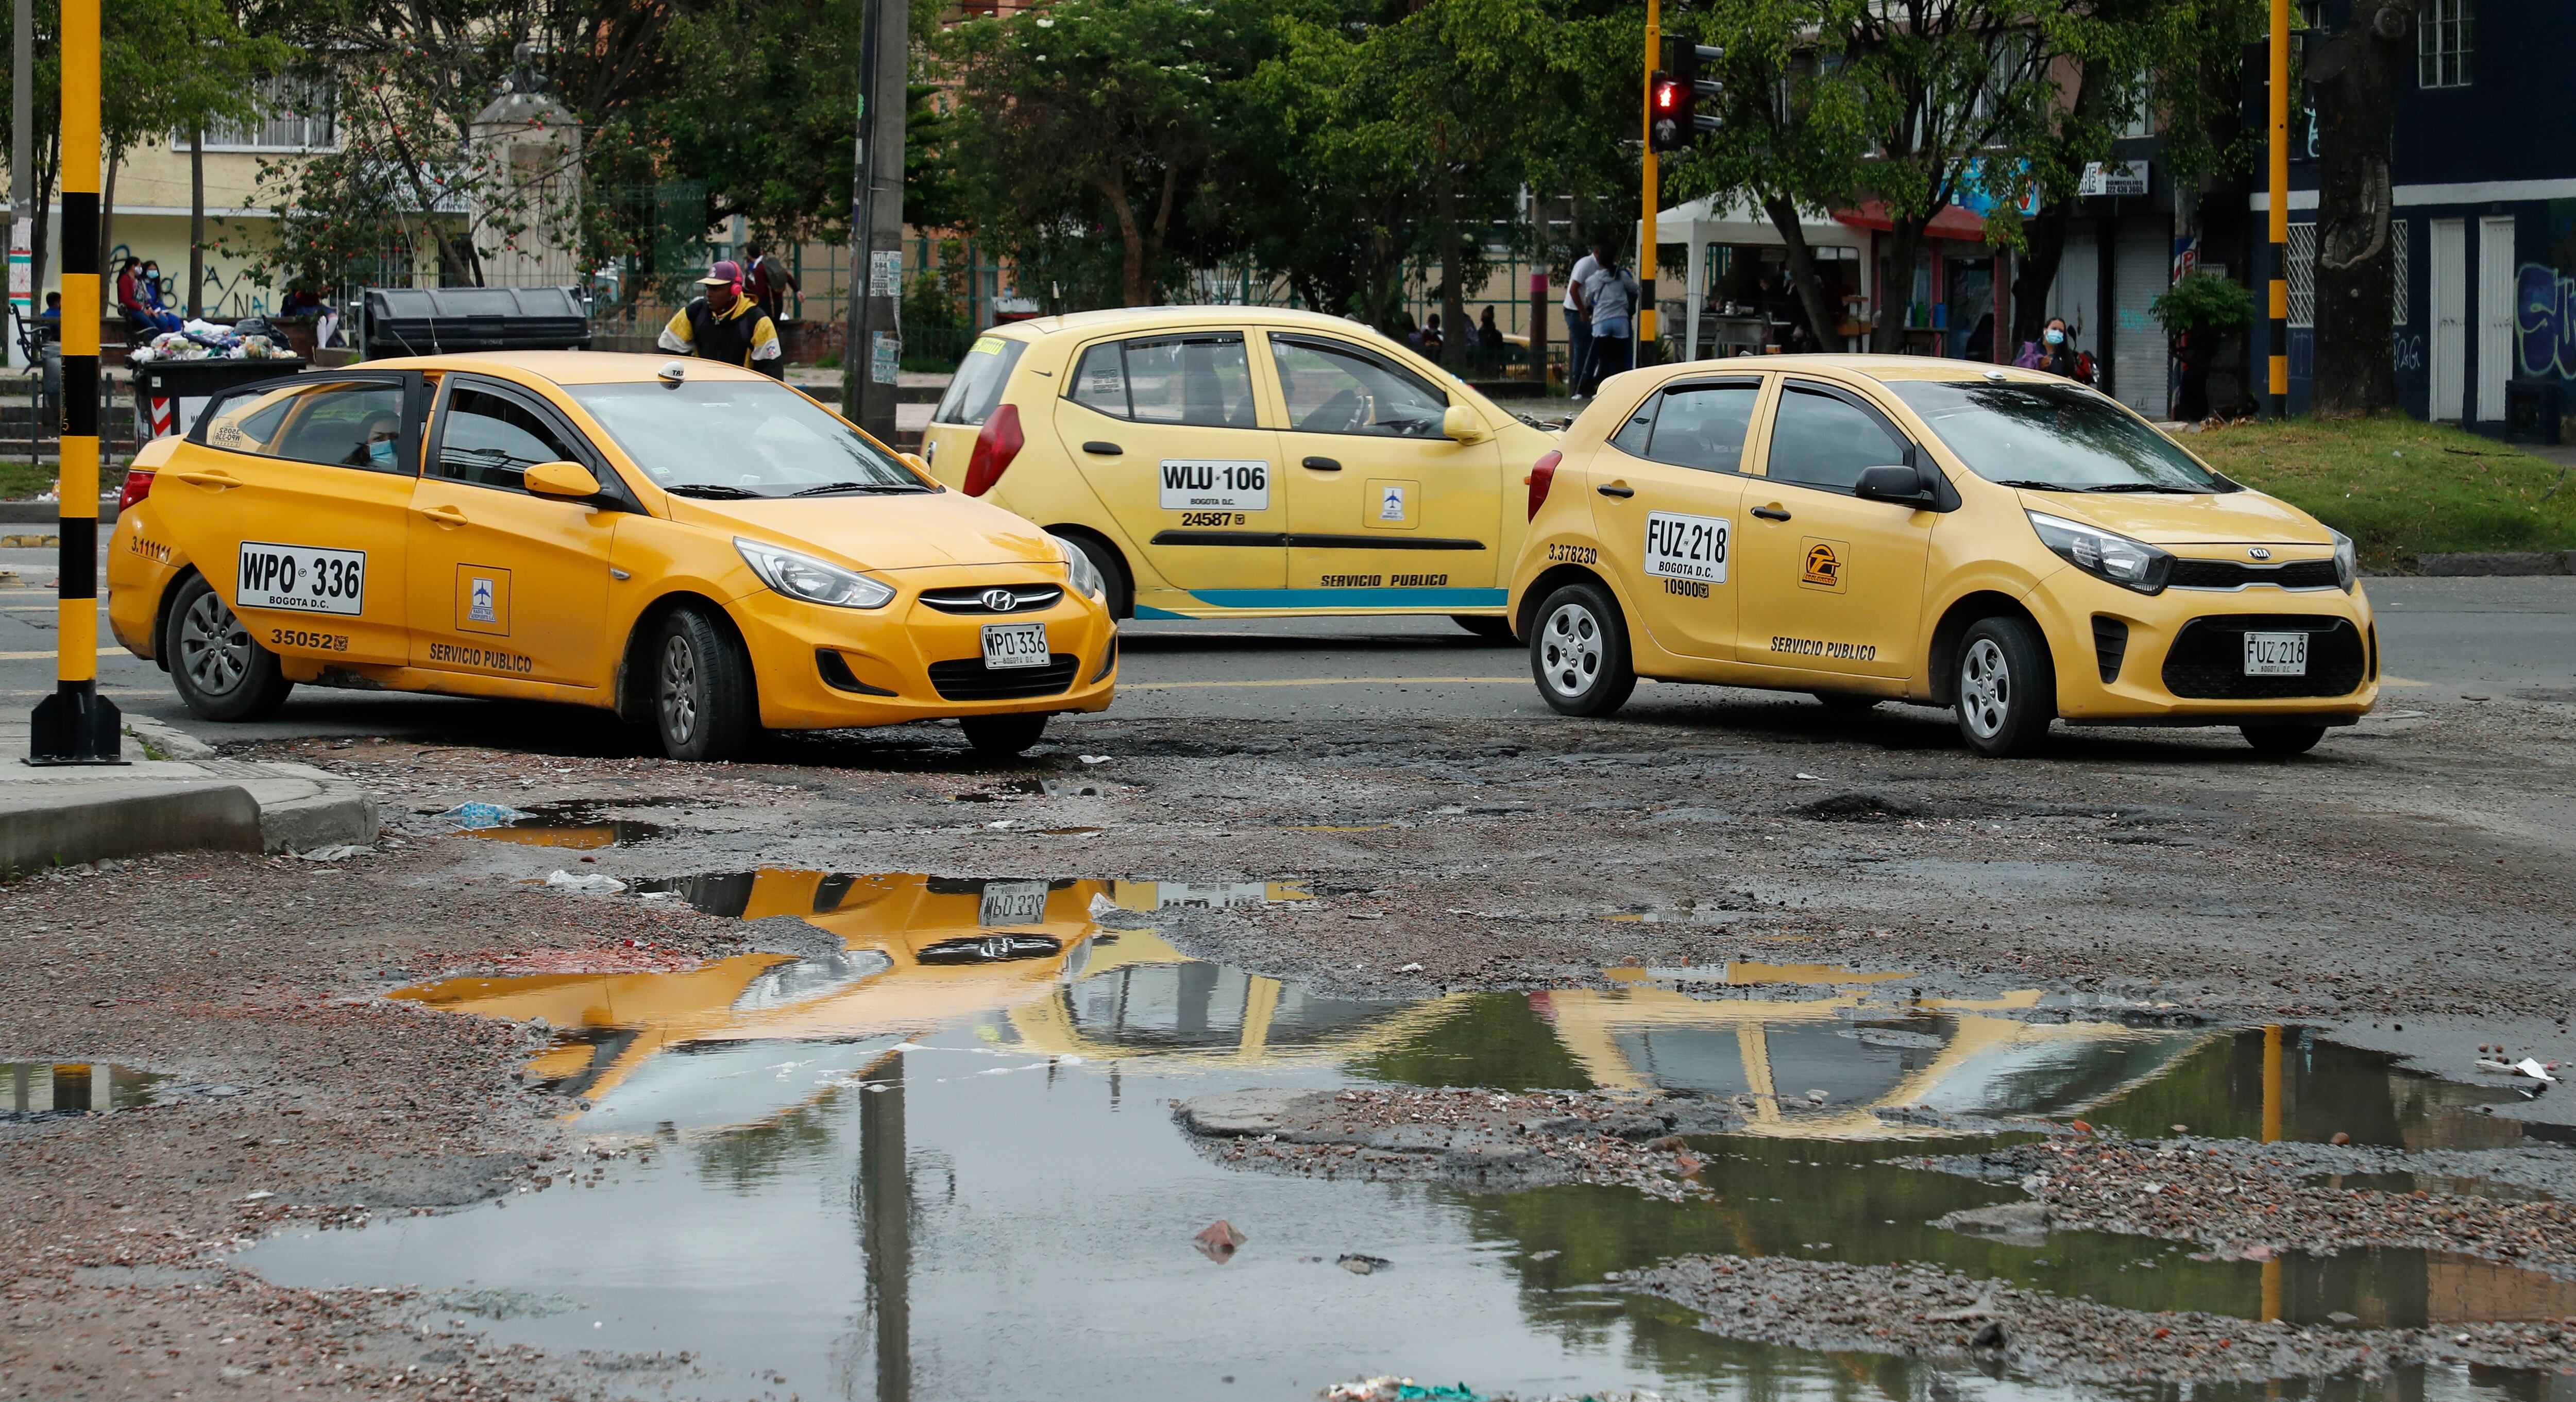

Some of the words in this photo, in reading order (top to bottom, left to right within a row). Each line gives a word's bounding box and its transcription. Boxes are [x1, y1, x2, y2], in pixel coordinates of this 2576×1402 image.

[1163, 466, 1212, 490] WLU
[1223, 467, 1265, 490] 106
[1182, 512, 1231, 526] 24587
[1648, 519, 1685, 558] FUZ
[1690, 524, 1727, 563] 218
[1548, 543, 1597, 565] 3.378230
[2251, 549, 2270, 557] KIA
[243, 552, 297, 594] WPO
[312, 557, 360, 599] 336
[1321, 574, 1382, 587] SERVICIO
[1390, 574, 1448, 586] PUBLICO
[1658, 561, 1693, 575] BOGOTA
[1695, 565, 1713, 578] D.C.
[1664, 578, 1698, 597] 10900
[269, 595, 308, 608] BOGOTA
[311, 600, 329, 609] D.C.
[270, 628, 333, 650] 35052
[985, 632, 1015, 656] WPO
[1016, 630, 1046, 654] 336
[1771, 636, 1823, 657] SERVICIO
[1825, 642, 1876, 661] PUBLICO
[430, 642, 481, 666] SERVICIO
[483, 650, 532, 674] PUBLICO
[2248, 641, 2275, 664] FUZ
[2279, 641, 2305, 664] 218
